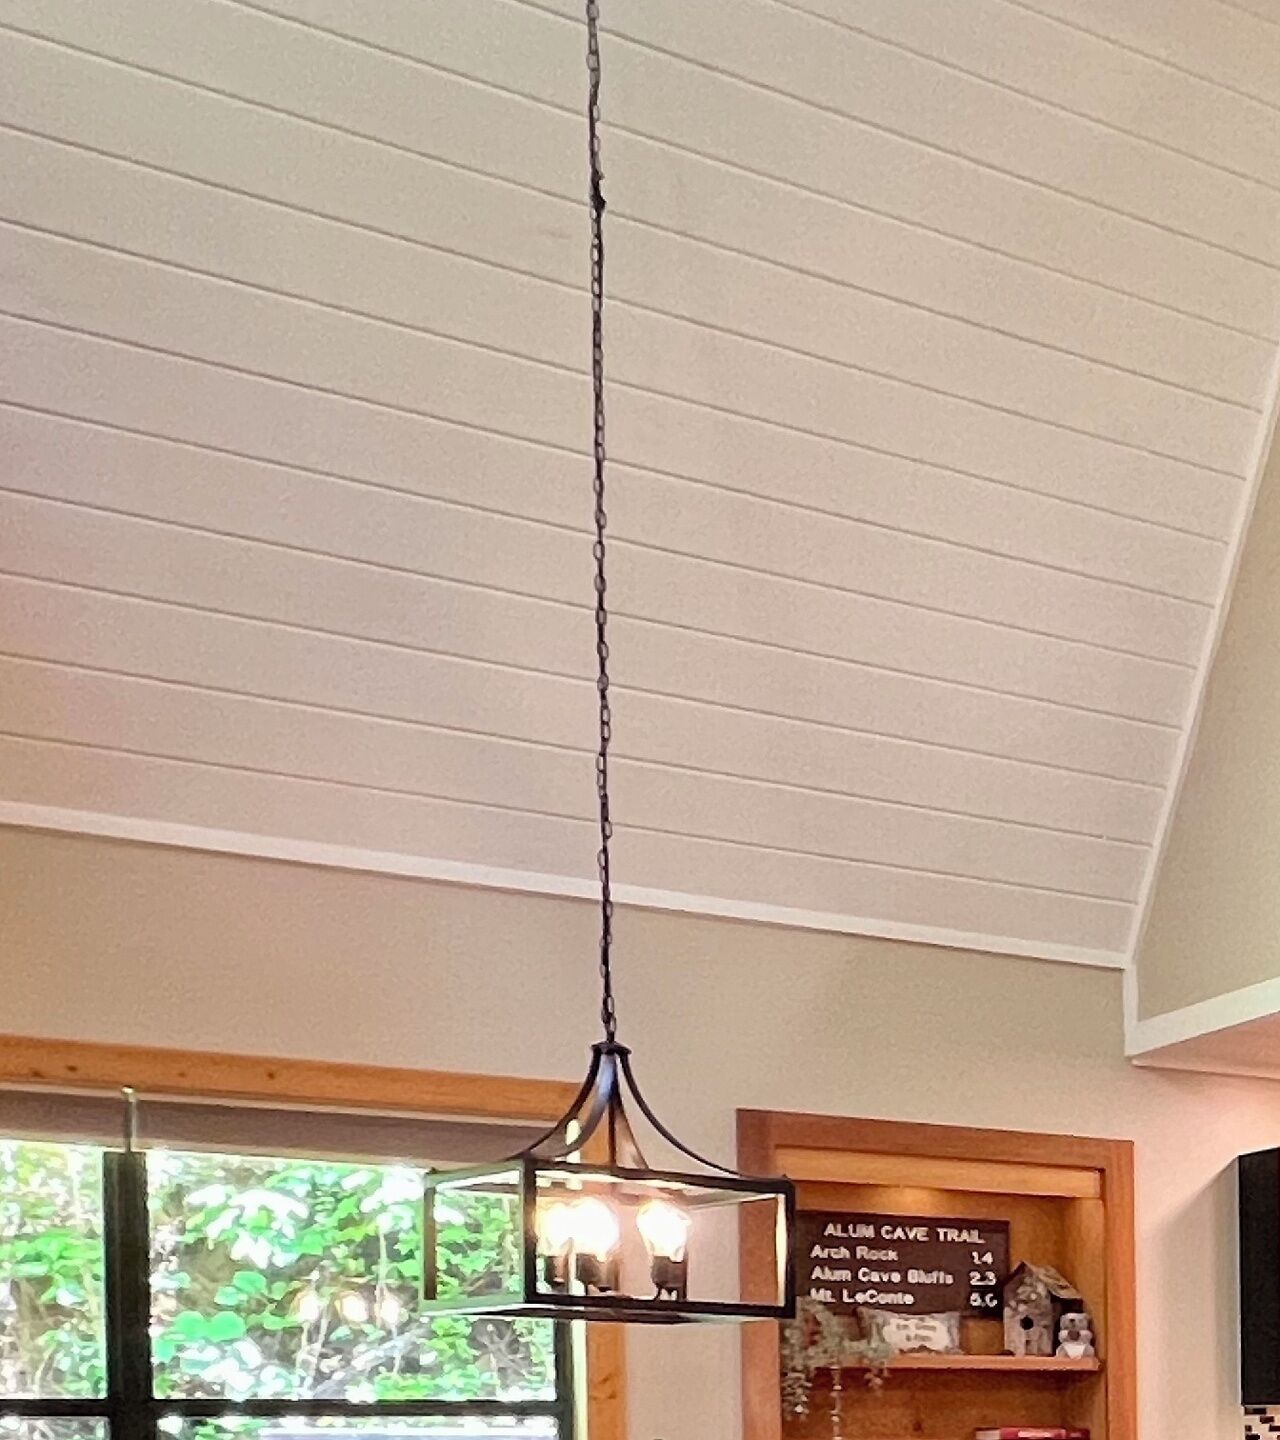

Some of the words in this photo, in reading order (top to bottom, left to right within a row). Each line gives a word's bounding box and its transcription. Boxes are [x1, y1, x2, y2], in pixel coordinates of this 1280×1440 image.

[824, 1222, 875, 1239] ALUM
[881, 1225, 930, 1242] CAVE
[936, 1226, 986, 1244] TRAIL
[810, 1244, 851, 1260] Arch
[856, 1245, 899, 1261] Rock
[811, 1265, 852, 1282] Alum
[857, 1267, 901, 1284] Cave
[907, 1268, 954, 1285] Bluffs
[842, 1288, 915, 1306] LeConte
